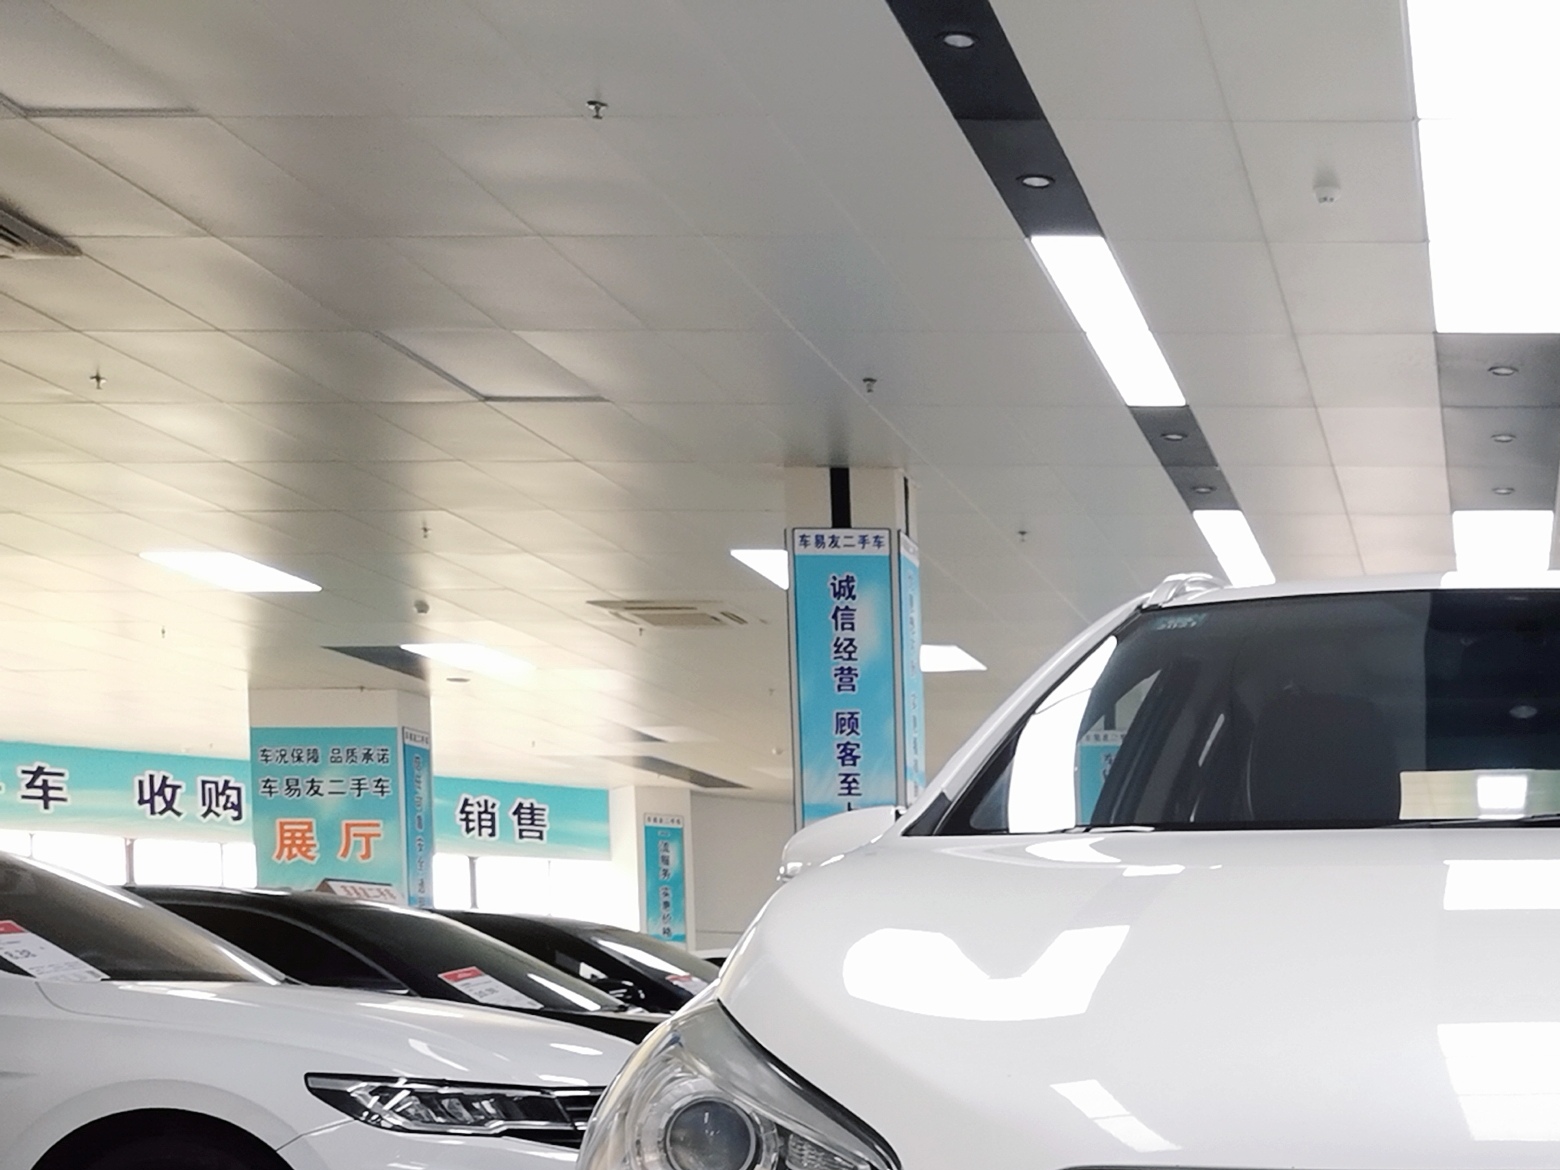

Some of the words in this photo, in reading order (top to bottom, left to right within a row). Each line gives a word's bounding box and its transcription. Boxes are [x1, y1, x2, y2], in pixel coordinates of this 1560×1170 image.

[798, 533, 886, 550] 车易友二手车
[830, 574, 859, 693] 诚信经营
[259, 747, 321, 765] 车况保障
[329, 748, 391, 765] 品质承诺
[18, 765, 68, 810] 车
[137, 773, 243, 821] 收购
[260, 777, 392, 798] 车易友二手车
[459, 797, 547, 841] 销售
[274, 820, 382, 862] 展厅
